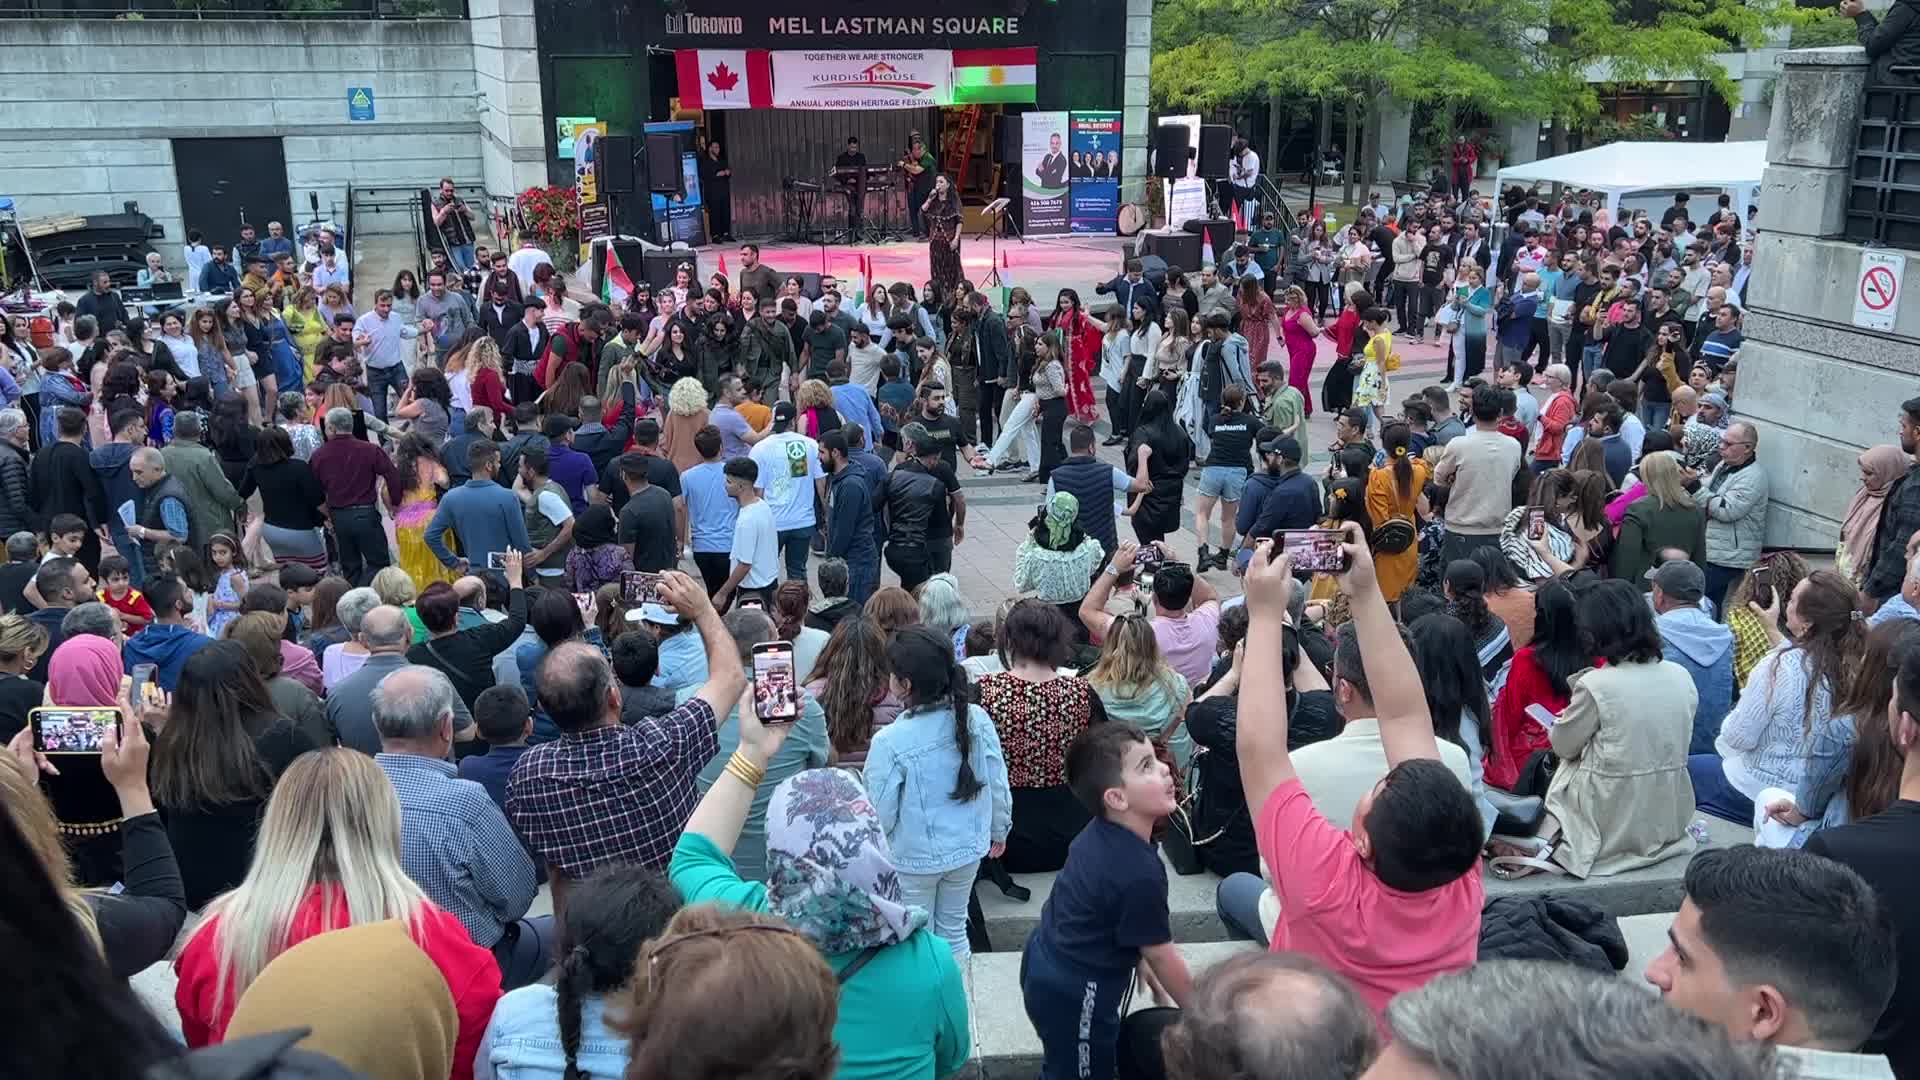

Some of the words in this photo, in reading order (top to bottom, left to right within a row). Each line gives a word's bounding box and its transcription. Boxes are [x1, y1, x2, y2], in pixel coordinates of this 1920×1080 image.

[685, 12, 743, 34] TORONTO
[768, 16, 814, 35] MEL
[820, 16, 925, 35] LASTMAN
[932, 16, 1019, 35] SQUARE
[803, 52, 847, 61] TOGETHER
[848, 53, 861, 61] WE
[862, 53, 879, 61] ARE
[880, 52, 925, 61] STRONGER
[811, 73, 868, 82] KURDISH
[874, 72, 917, 81] HOUSE
[789, 99, 822, 108] ANNUAL
[823, 99, 860, 107] KURDISH
[860, 98, 901, 107] HERITAGE
[901, 97, 937, 106] FESTIVAL
[1078, 981, 1097, 1040] FASHION
[1078, 1041, 1091, 1079] GIRLS
